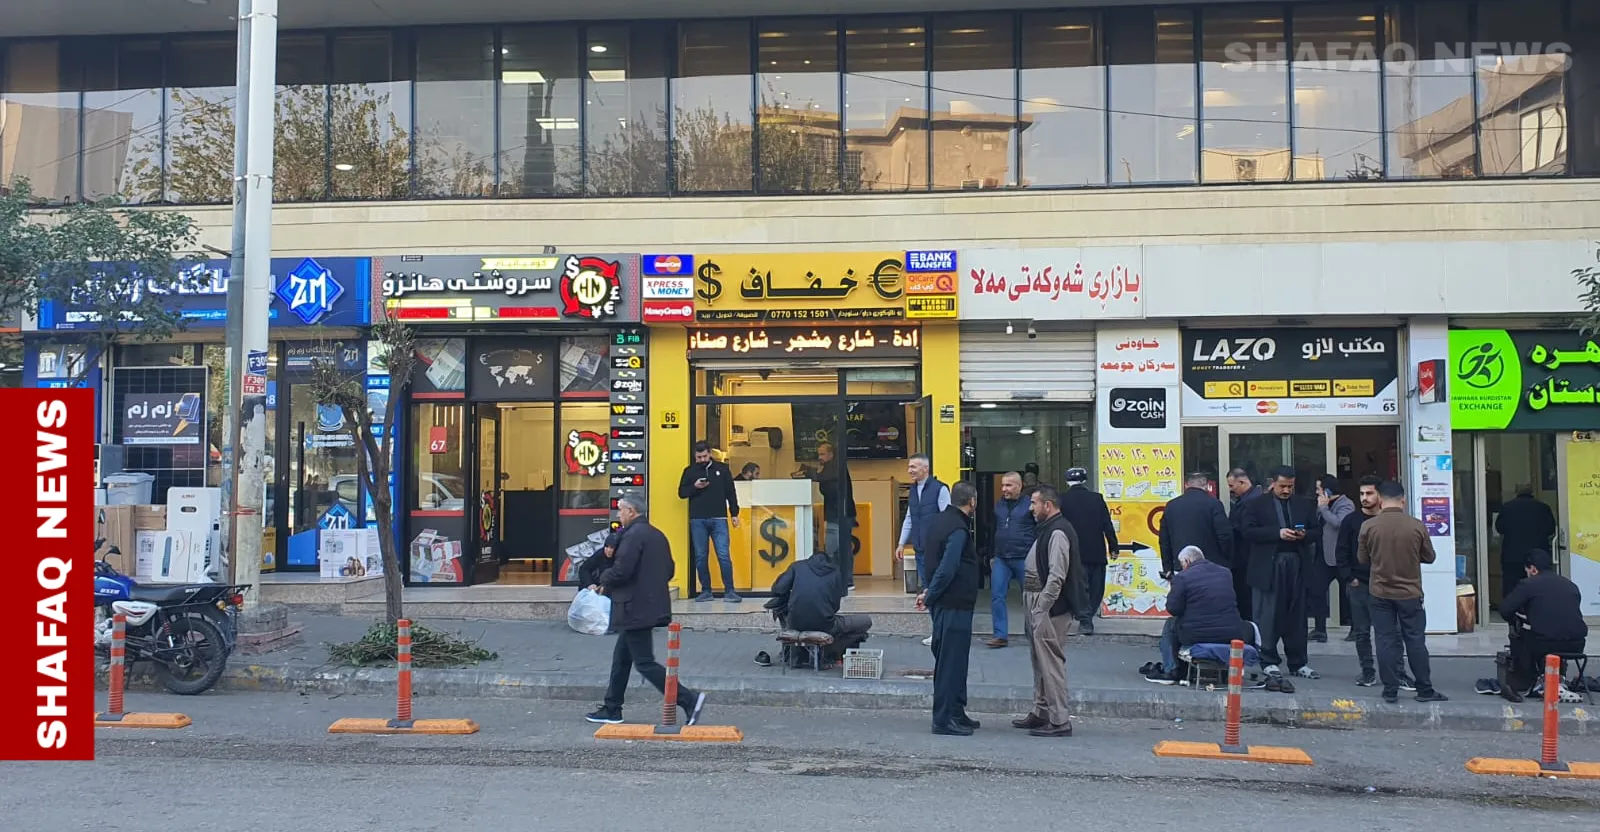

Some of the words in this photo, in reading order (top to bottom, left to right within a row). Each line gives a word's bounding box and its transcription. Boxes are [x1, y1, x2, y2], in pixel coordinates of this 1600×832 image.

[920, 252, 952, 262] BANK
[739, 266, 859, 300] خفاف
[771, 310, 791, 318] 0770
[732, 331, 768, 352] شارع
[838, 330, 874, 351] شارع
[1302, 338, 1334, 359] لازو
[1338, 337, 1385, 358] مكتب
[1126, 398, 1165, 412] zain
[1382, 403, 1396, 412] 65
[664, 412, 676, 422] 66
[1140, 411, 1165, 419] CASH
[430, 440, 446, 450] 67
